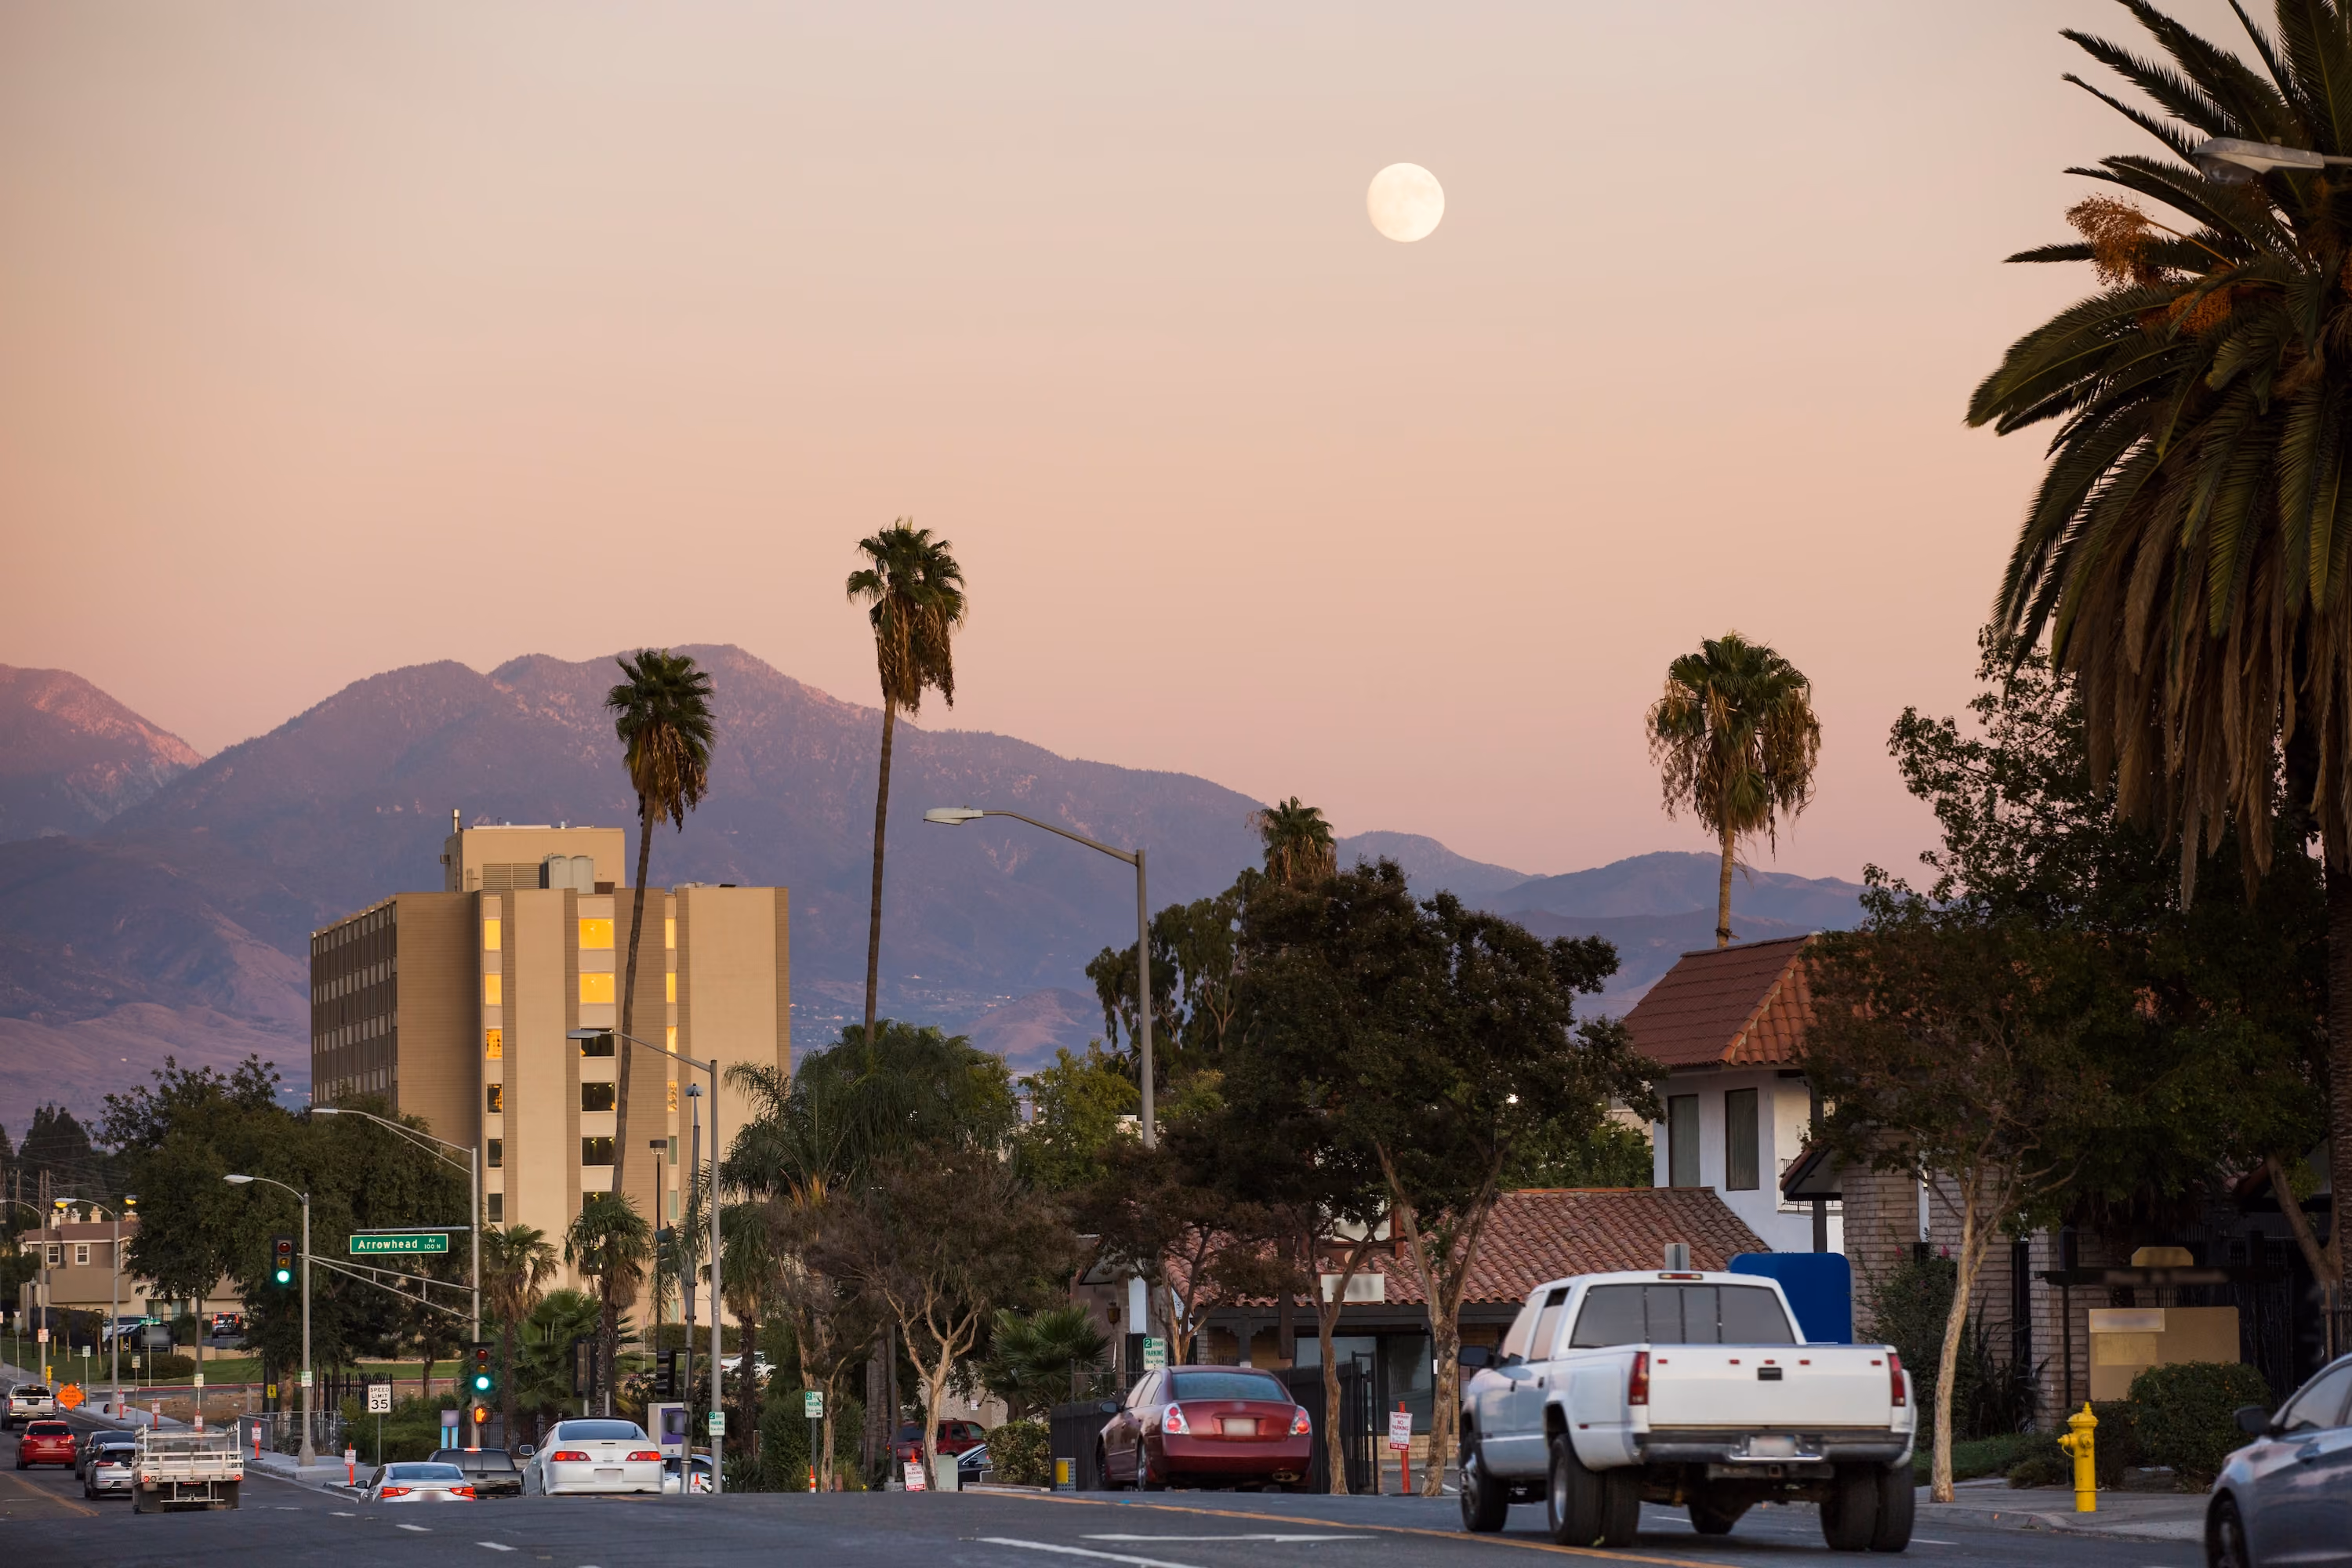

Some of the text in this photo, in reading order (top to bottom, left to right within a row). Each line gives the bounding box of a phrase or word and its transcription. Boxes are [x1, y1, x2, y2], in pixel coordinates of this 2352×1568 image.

[358, 1240, 418, 1250] Arrowhead
[1145, 1339, 1151, 1348] 2
[371, 1399, 388, 1410] 35
